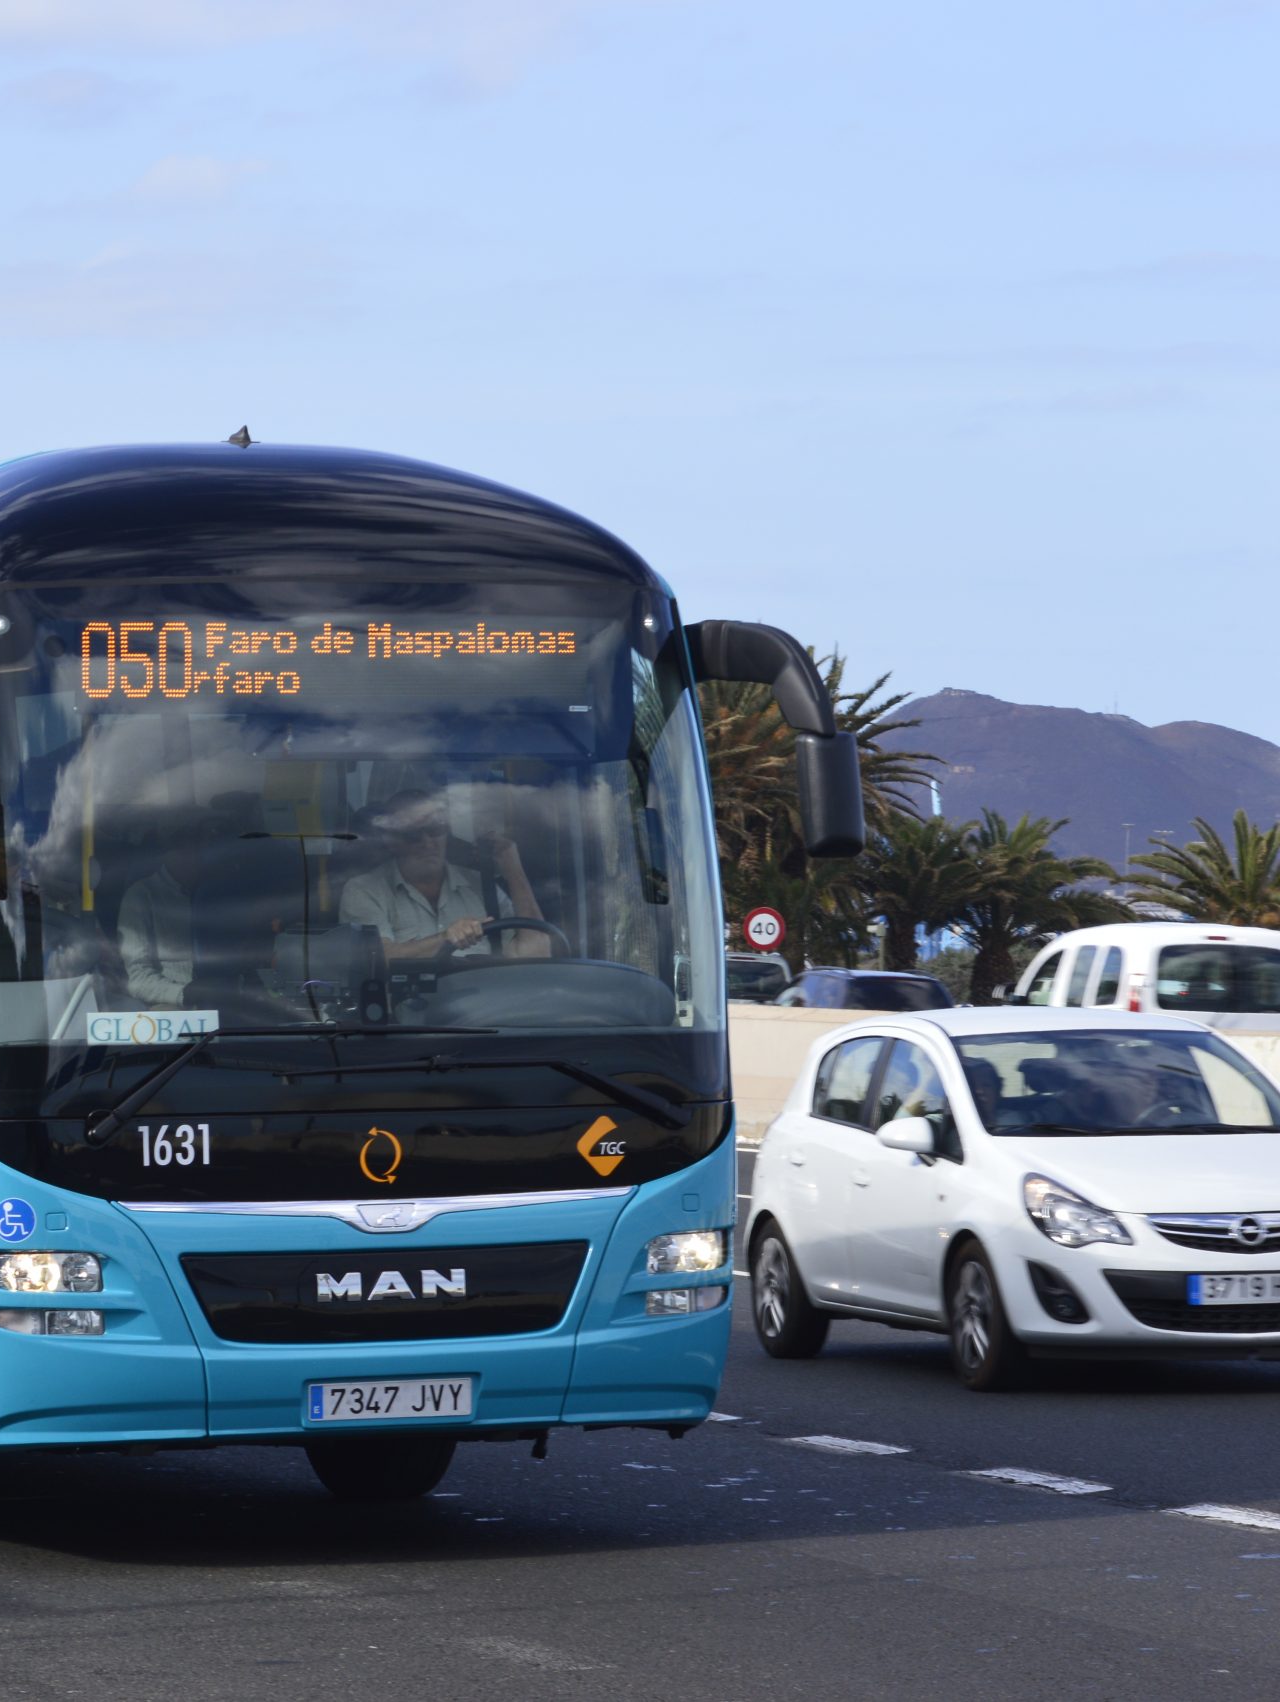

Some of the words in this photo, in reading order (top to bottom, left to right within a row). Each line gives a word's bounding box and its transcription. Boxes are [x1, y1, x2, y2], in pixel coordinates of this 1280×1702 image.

[205, 622, 299, 658] Faro
[310, 622, 355, 654] de
[367, 622, 577, 659] Maspalomas
[81, 621, 193, 699] 050
[752, 922, 776, 935] 40
[137, 1123, 212, 1167] 1631
[599, 1141, 627, 1155] TGC
[315, 1268, 467, 1302] MAN
[330, 1386, 400, 1416] 7347
[411, 1384, 463, 1413] JVY
